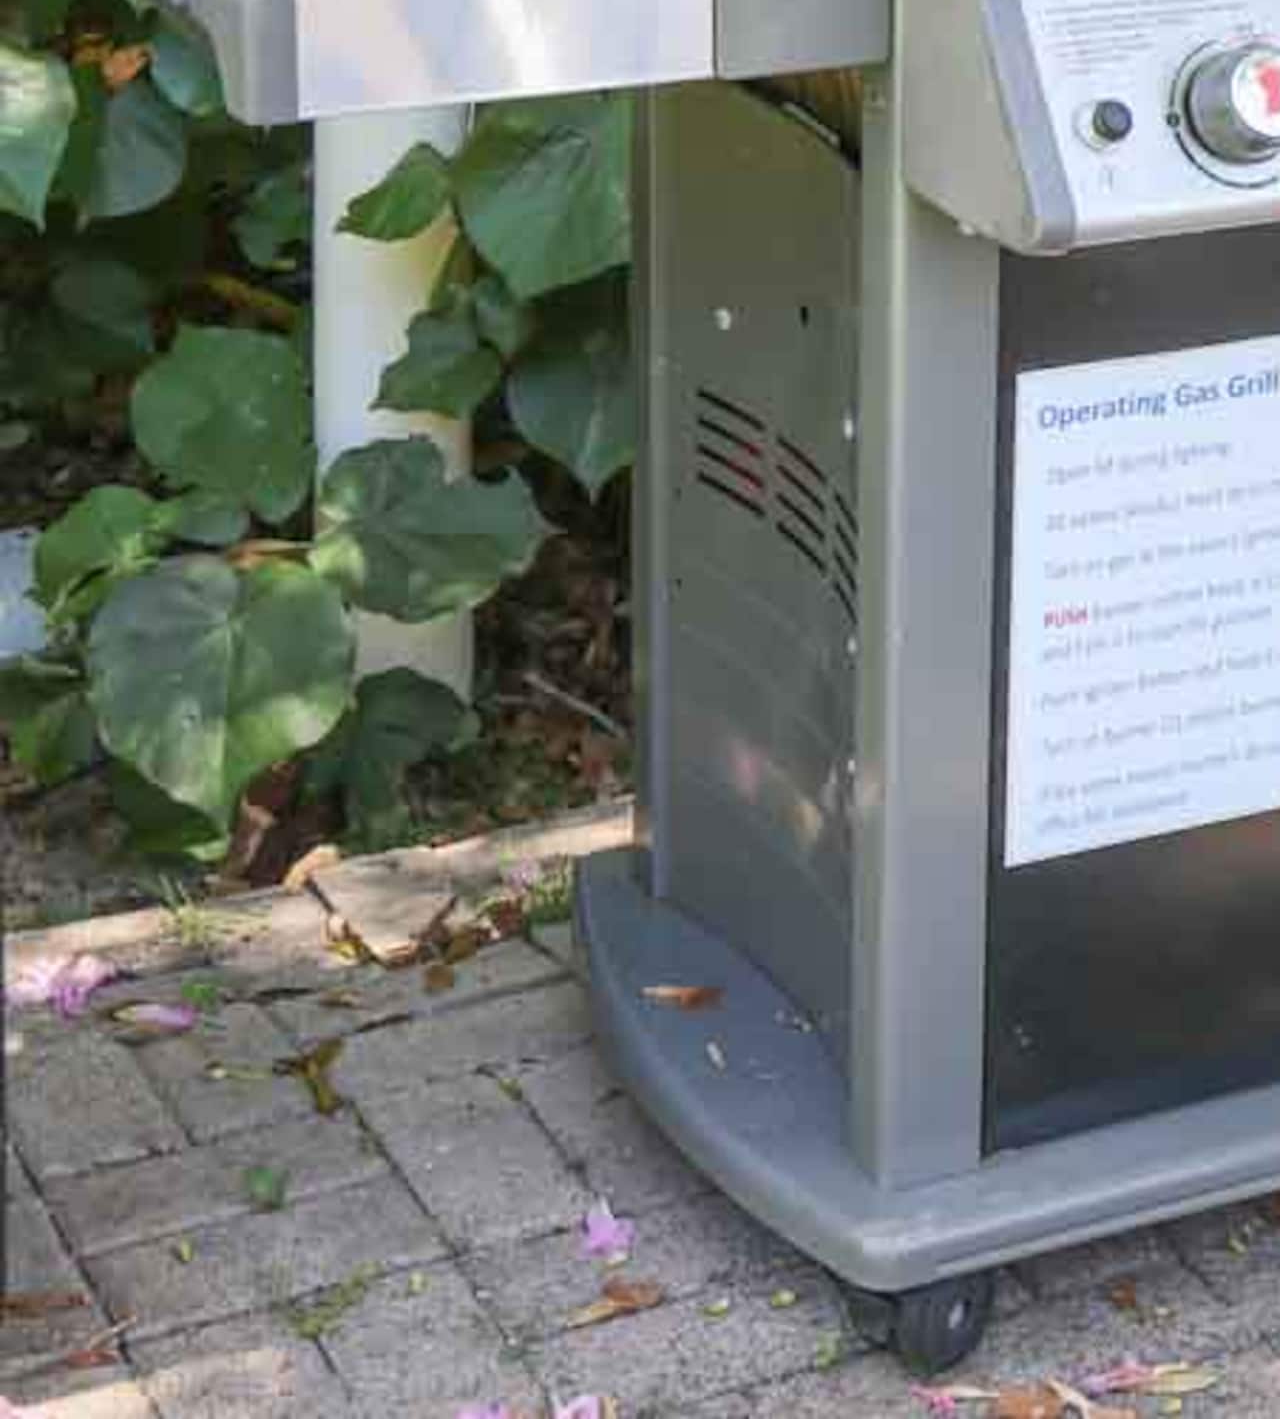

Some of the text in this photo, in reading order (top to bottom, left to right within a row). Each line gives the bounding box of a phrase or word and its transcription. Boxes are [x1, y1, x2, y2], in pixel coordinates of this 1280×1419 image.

[1038, 366, 1280, 431] Operating Gas Grill
